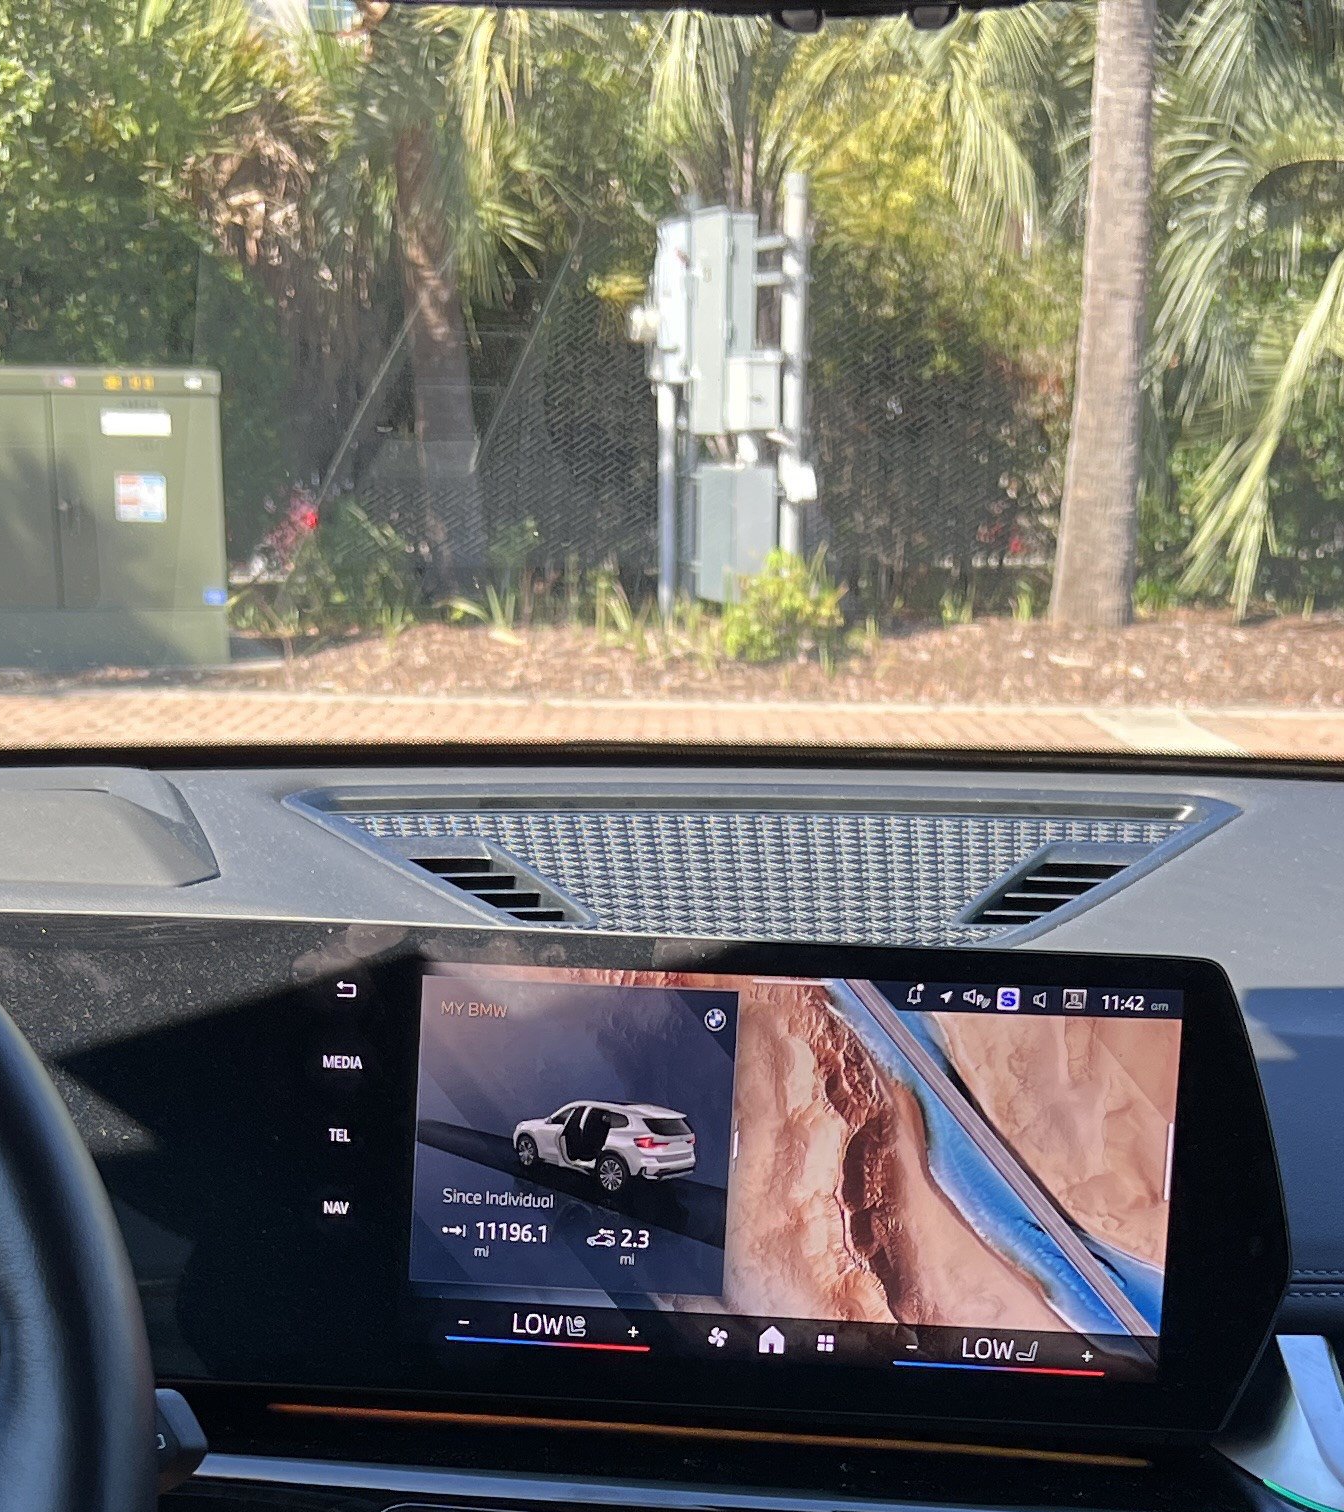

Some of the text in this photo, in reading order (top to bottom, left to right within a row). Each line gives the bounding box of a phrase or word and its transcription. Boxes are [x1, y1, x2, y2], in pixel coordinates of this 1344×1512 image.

[440, 1000, 508, 1019] MY BMW
[1101, 994, 1169, 1012] 11:42 am
[322, 1054, 363, 1070] MEDIA
[328, 1127, 351, 1143] TEL
[323, 1200, 350, 1216] NAV
[442, 1187, 555, 1209] Since Individual
[475, 1221, 651, 1249] 11196.1 2.3
[473, 1245, 636, 1266] mi mi
[512, 1312, 564, 1335] LOW
[962, 1337, 1015, 1360] LOW
